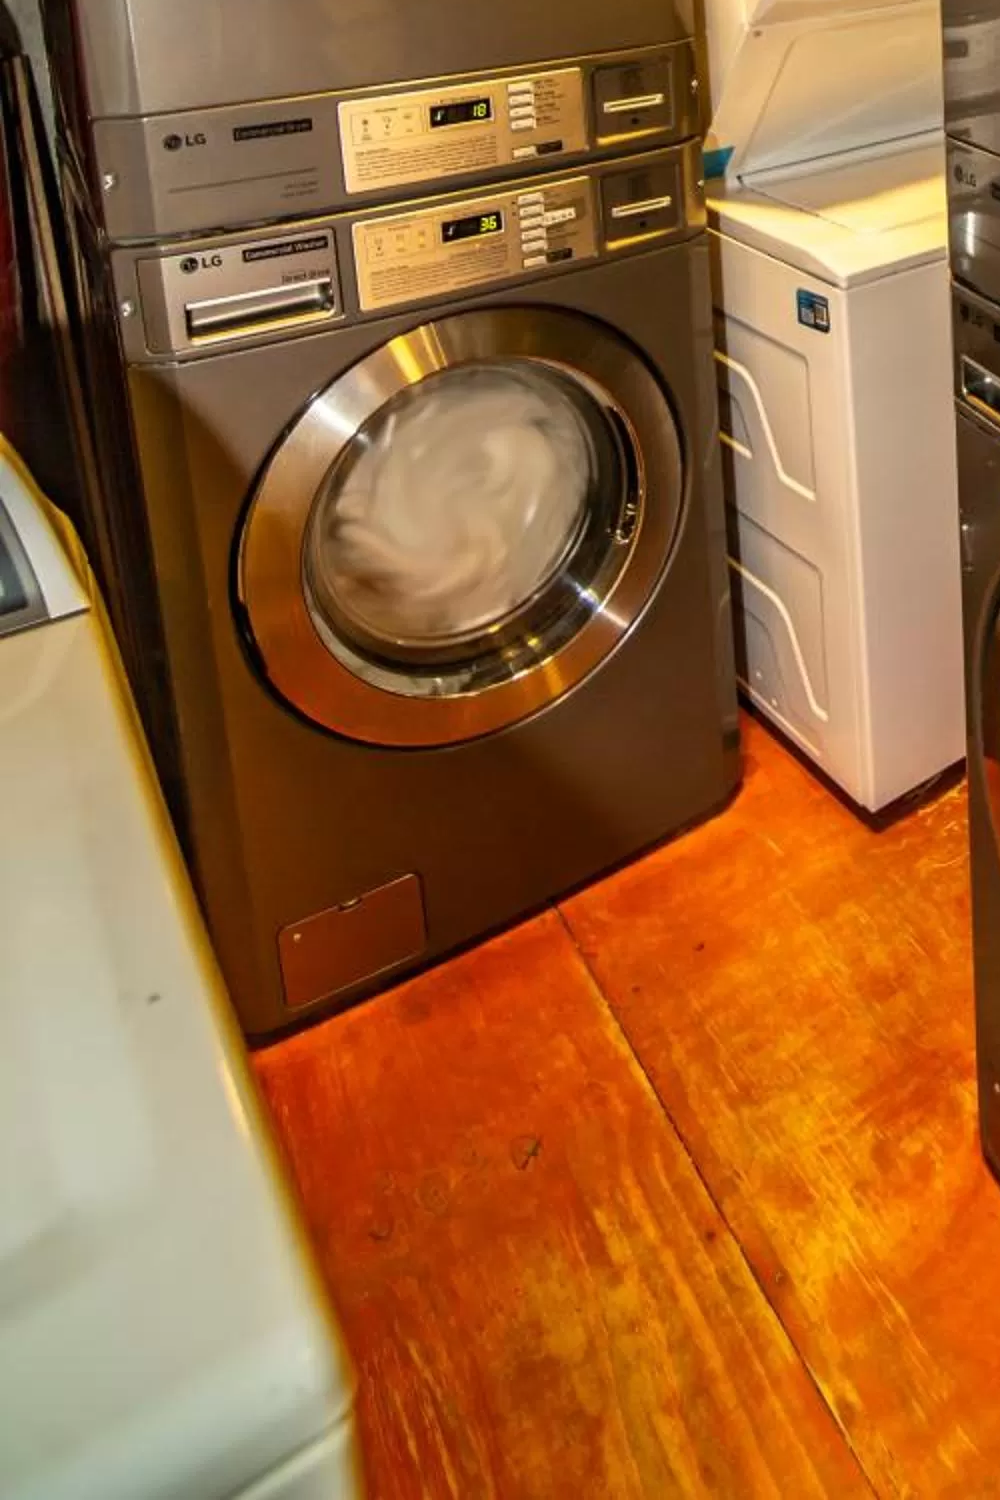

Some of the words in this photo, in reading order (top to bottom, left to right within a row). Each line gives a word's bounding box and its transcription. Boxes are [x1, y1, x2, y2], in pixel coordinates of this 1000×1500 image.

[185, 133, 207, 147] LG
[479, 215, 497, 233] 36
[202, 255, 222, 269] LG
